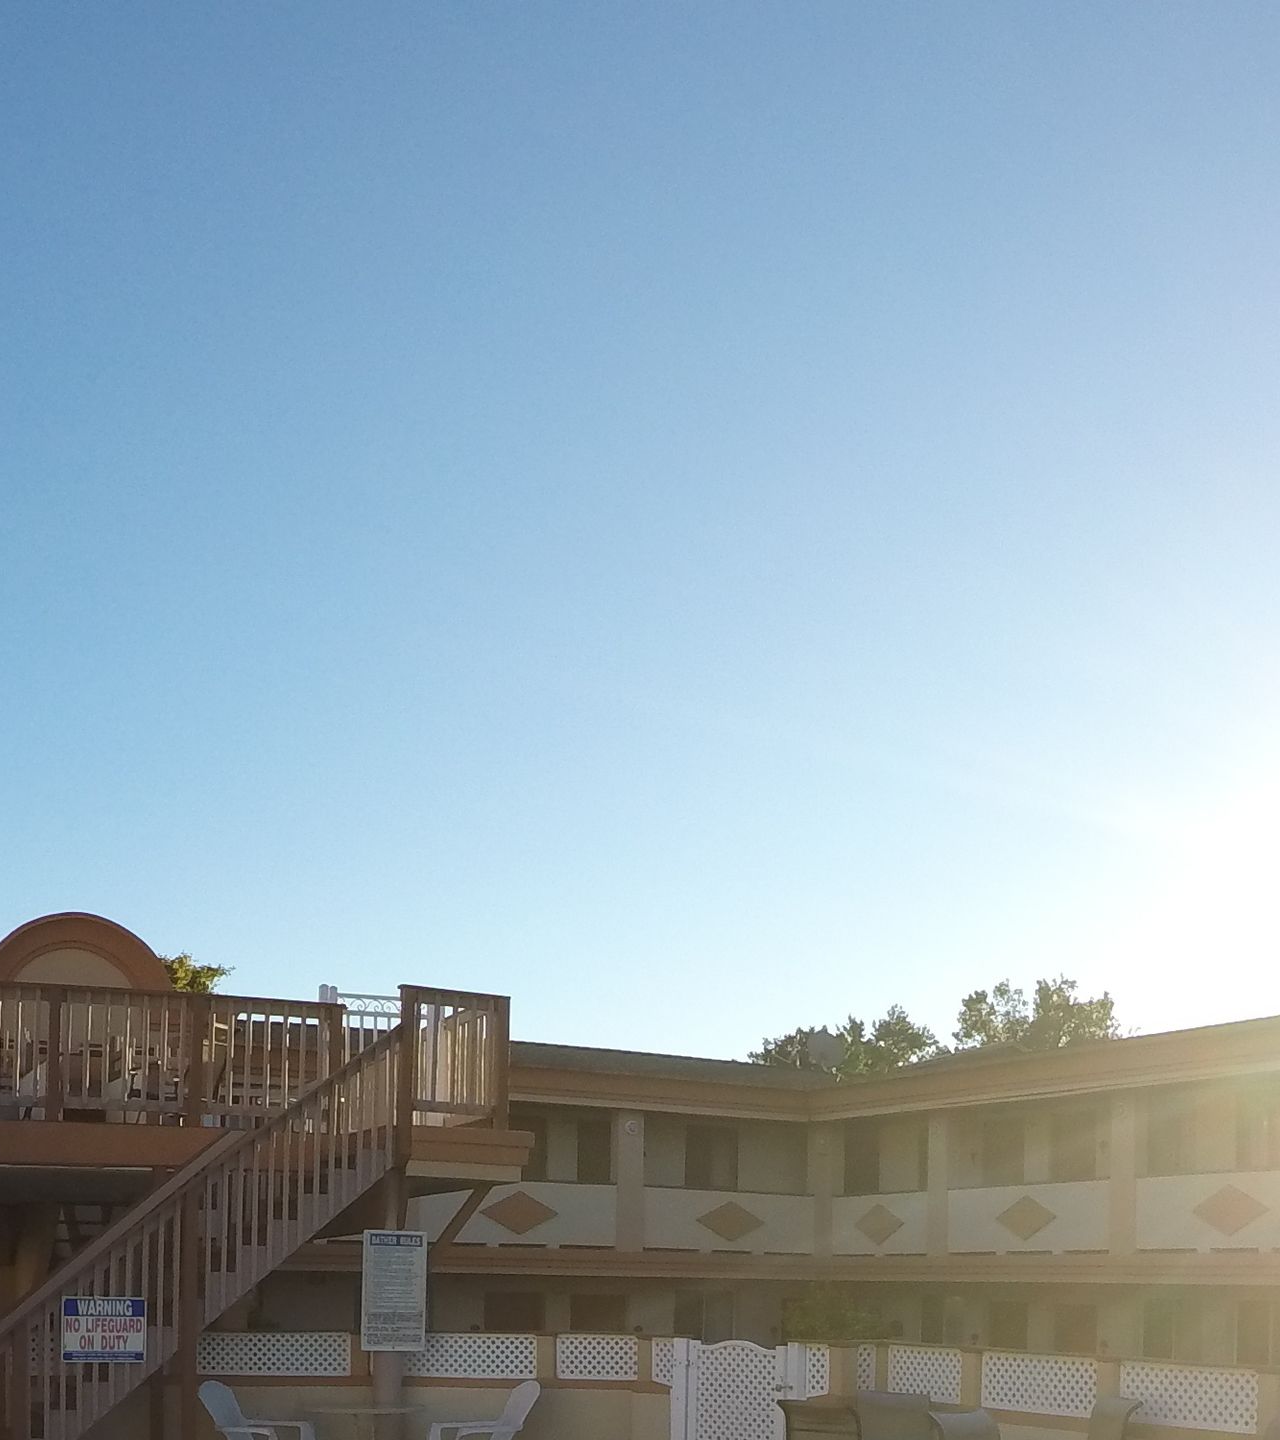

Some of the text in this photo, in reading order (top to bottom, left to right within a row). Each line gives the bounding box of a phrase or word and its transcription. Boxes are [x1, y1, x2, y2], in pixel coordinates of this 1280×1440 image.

[77, 1300, 133, 1316] WARNING
[65, 1318, 142, 1333] NO LIFEGUARD
[79, 1335, 128, 1350] ON DUTY
